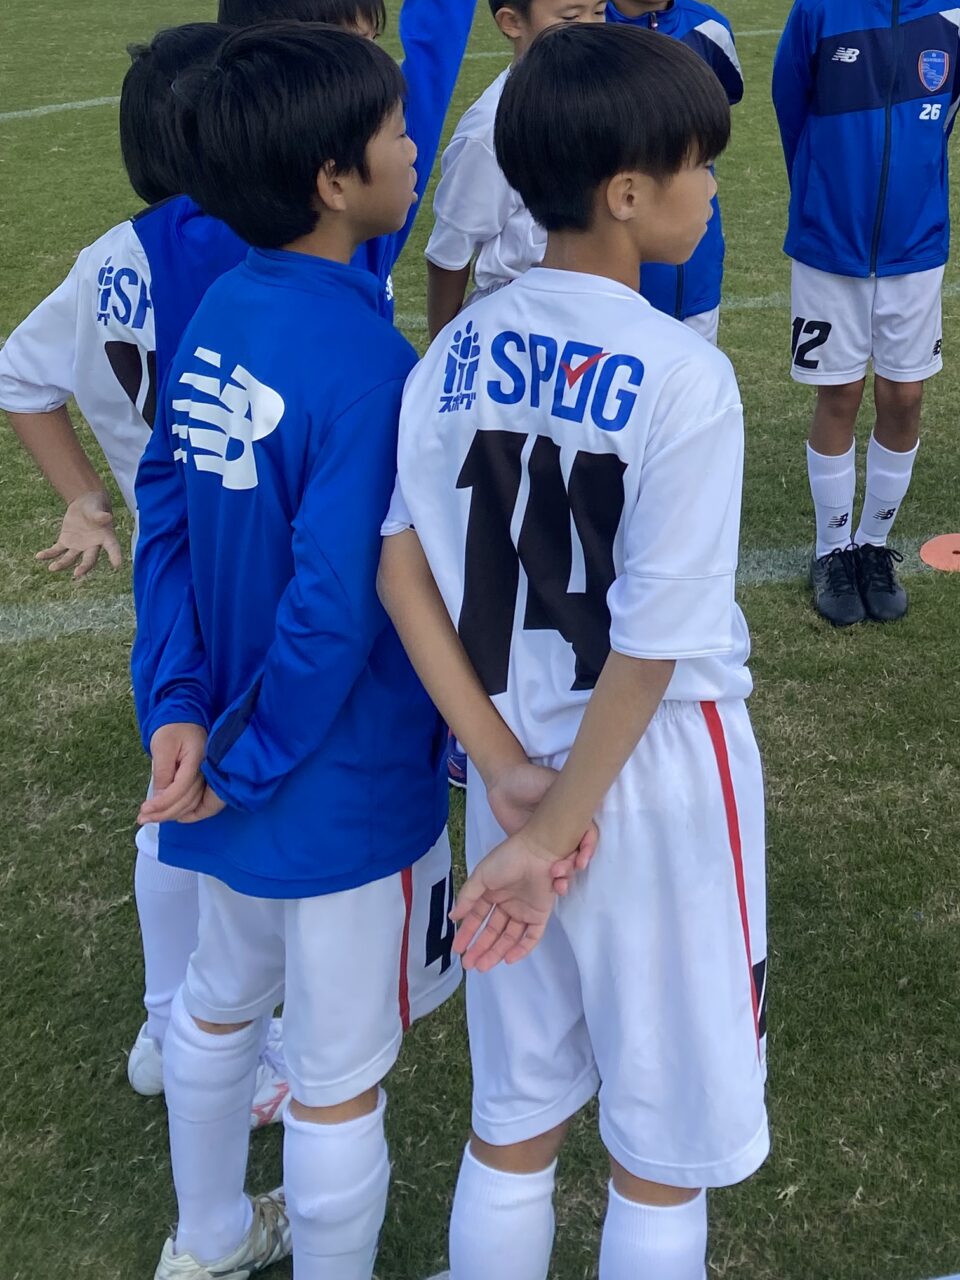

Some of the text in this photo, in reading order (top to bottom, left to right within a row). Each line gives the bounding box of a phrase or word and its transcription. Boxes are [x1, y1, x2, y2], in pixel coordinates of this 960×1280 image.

[919, 103, 942, 120] 26
[486, 330, 645, 432] SPOG
[792, 316, 832, 369] 12
[456, 429, 629, 696] 14
